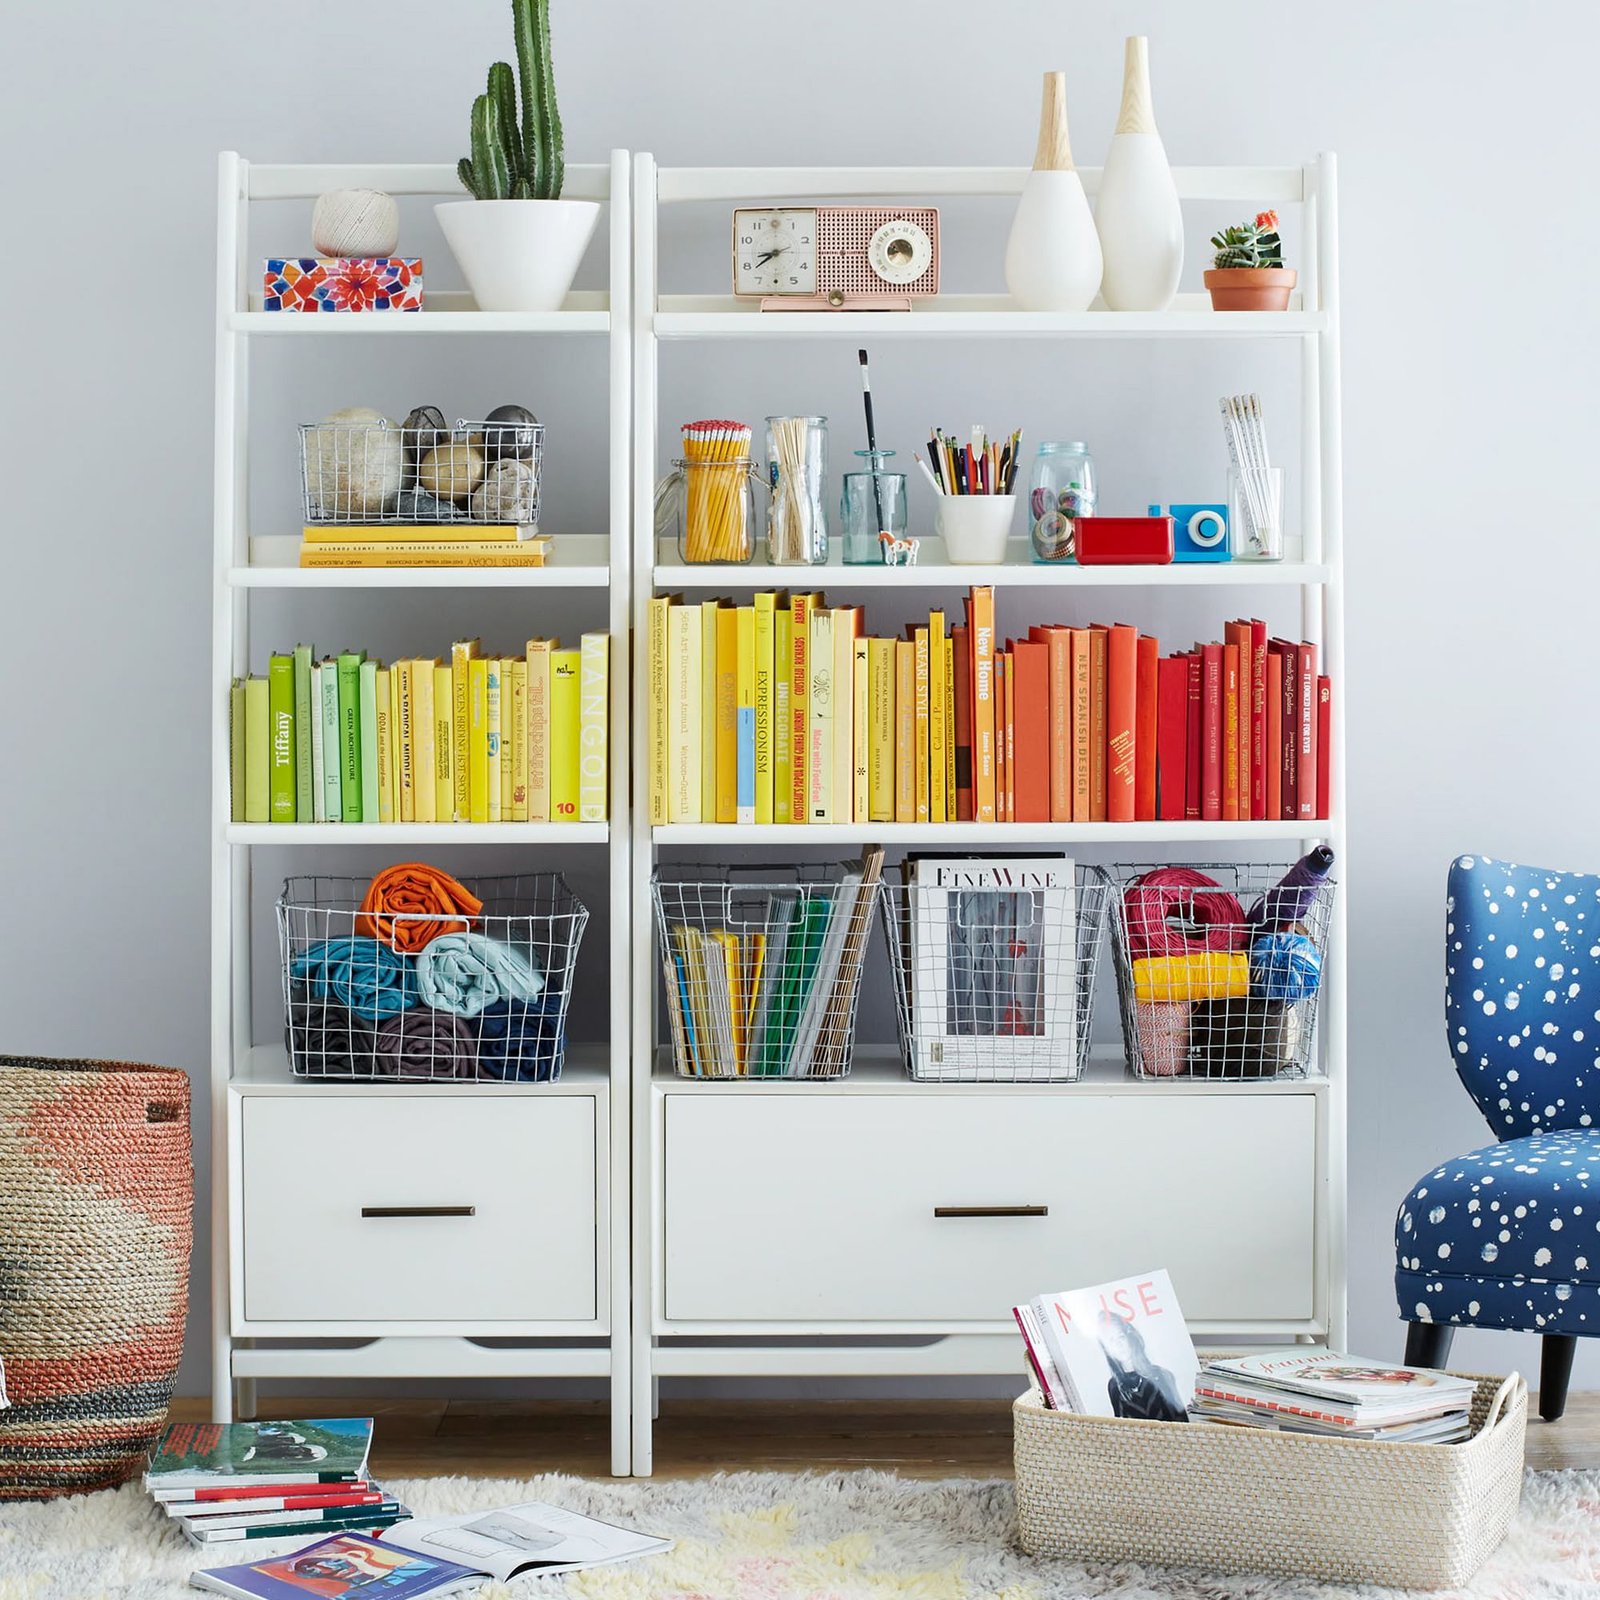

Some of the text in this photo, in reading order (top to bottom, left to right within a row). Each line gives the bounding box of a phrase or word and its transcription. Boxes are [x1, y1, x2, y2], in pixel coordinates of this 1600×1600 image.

[753, 222, 761, 230] 11
[800, 262, 808, 270] 4
[467, 558, 497, 567] TODAY
[502, 558, 536, 567] ARTISTS
[793, 599, 805, 624] ABRAMS
[680, 637, 690, 653] Art
[857, 652, 866, 660] K
[793, 637, 805, 696] COUSTEAU RICHARDS
[978, 627, 992, 701] New Home
[680, 655, 690, 701] Directors
[917, 640, 928, 719] SAFARI STYLE
[1253, 645, 1266, 713] Dickens of London
[1285, 675, 1294, 691] Royal
[1302, 673, 1311, 681] IT
[456, 683, 465, 713] DOZEN
[1208, 685, 1218, 706] JULY
[1285, 692, 1294, 715] Gardens
[1302, 681, 1311, 706] LOOKED
[680, 702, 689, 734] Annual
[757, 670, 768, 773] EXPRESSIONISM
[777, 682, 789, 763] UNDECORATE
[1078, 654, 1088, 796] NEW SPANISH DESIGN
[1302, 707, 1311, 723] LIKE
[275, 711, 293, 767] Tiffany
[456, 715, 466, 752] BIRDING
[581, 636, 605, 820] MANGOLD
[812, 729, 822, 750] Made
[347, 708, 356, 781] GREEN ARCHITECTURE
[982, 730, 991, 753] James
[457, 754, 466, 773] HOT
[793, 755, 805, 769] NEW
[812, 751, 822, 769] with
[457, 774, 467, 802] SPOTS
[679, 746, 690, 815] Watson-Guptill
[793, 769, 805, 788] PAPUA
[556, 802, 576, 814] 10
[1036, 1304, 1048, 1326] MUSE
